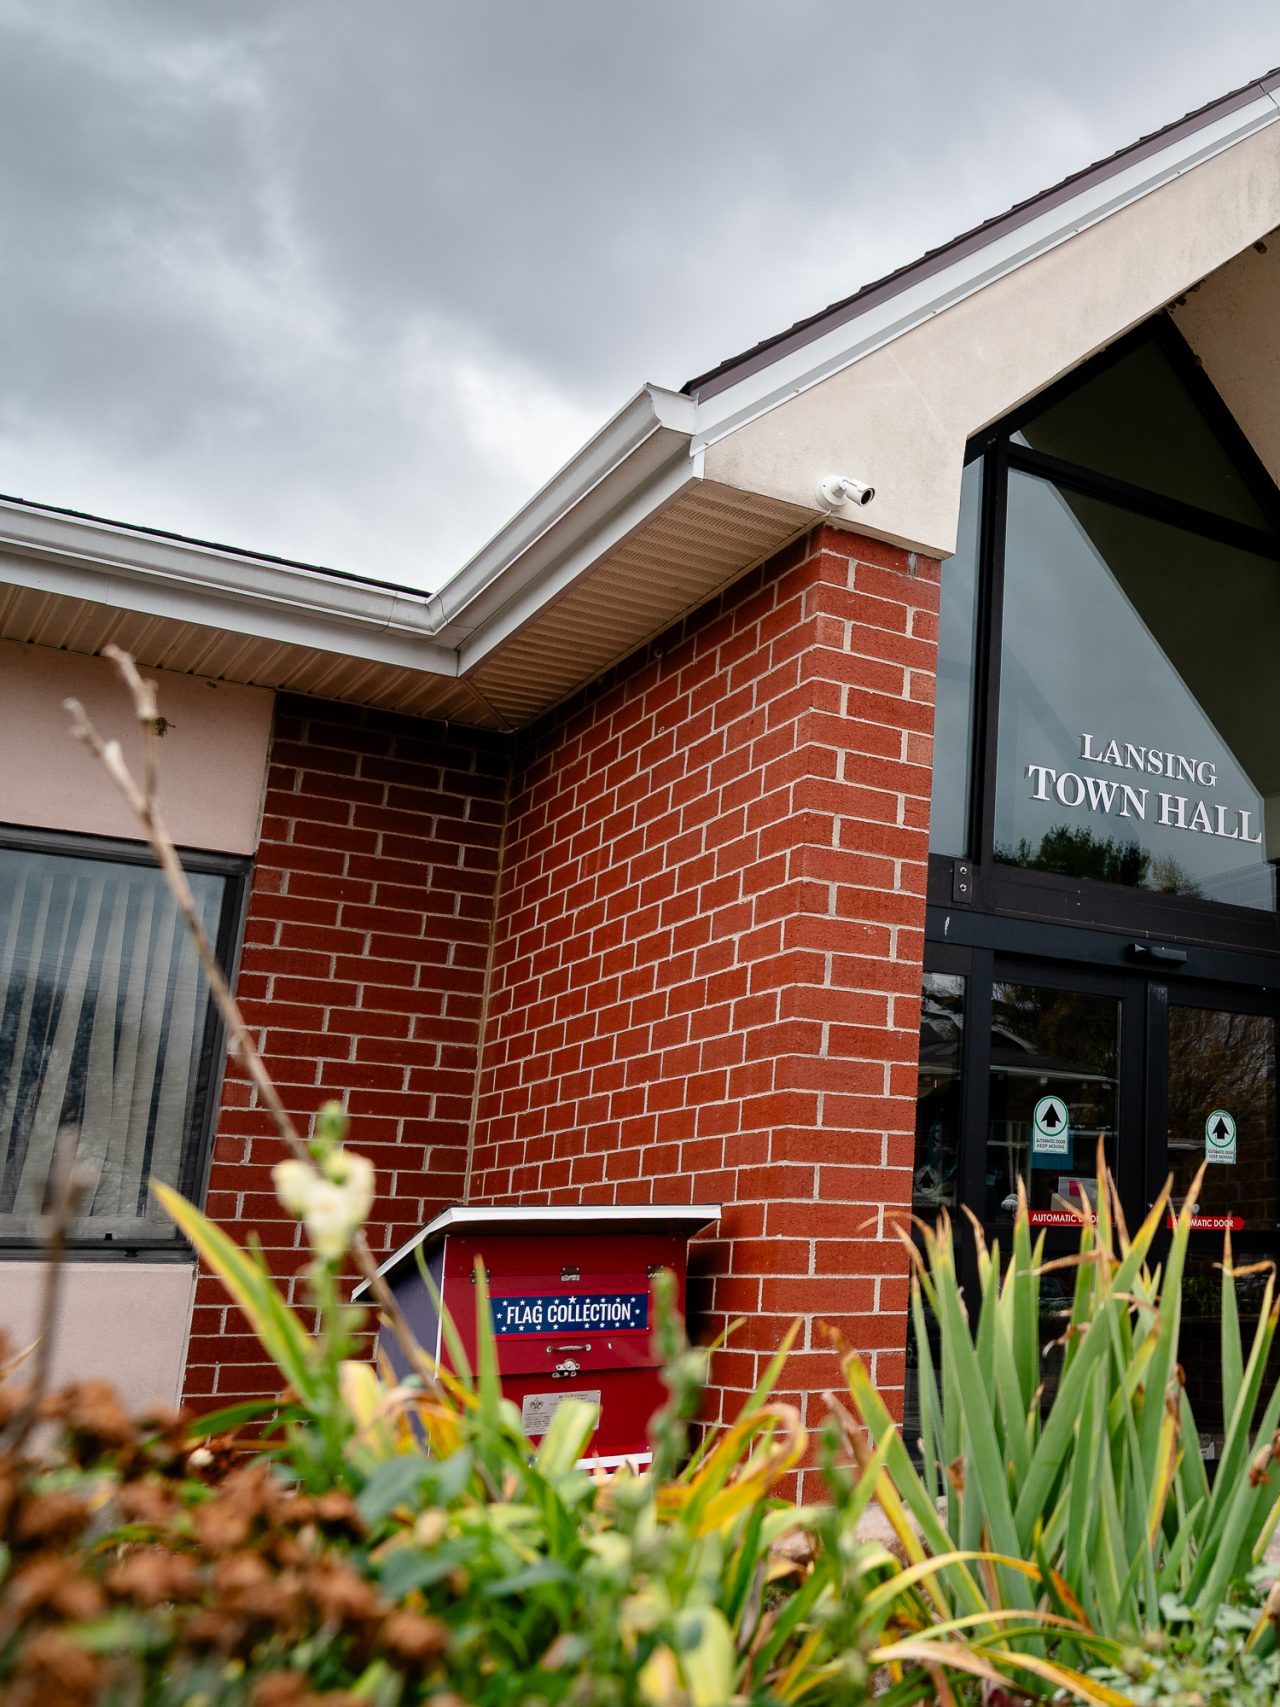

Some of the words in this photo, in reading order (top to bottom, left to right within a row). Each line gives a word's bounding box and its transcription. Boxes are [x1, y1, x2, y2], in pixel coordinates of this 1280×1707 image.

[1081, 732, 1217, 787] LANSING
[1028, 764, 1149, 820] TOWN
[1157, 791, 1262, 844] HALL
[1032, 1213, 1077, 1223] AUTOMATIC
[1213, 1219, 1234, 1228] DOOR
[506, 1305, 543, 1325] FLAG
[547, 1302, 631, 1323] COLLECTION
